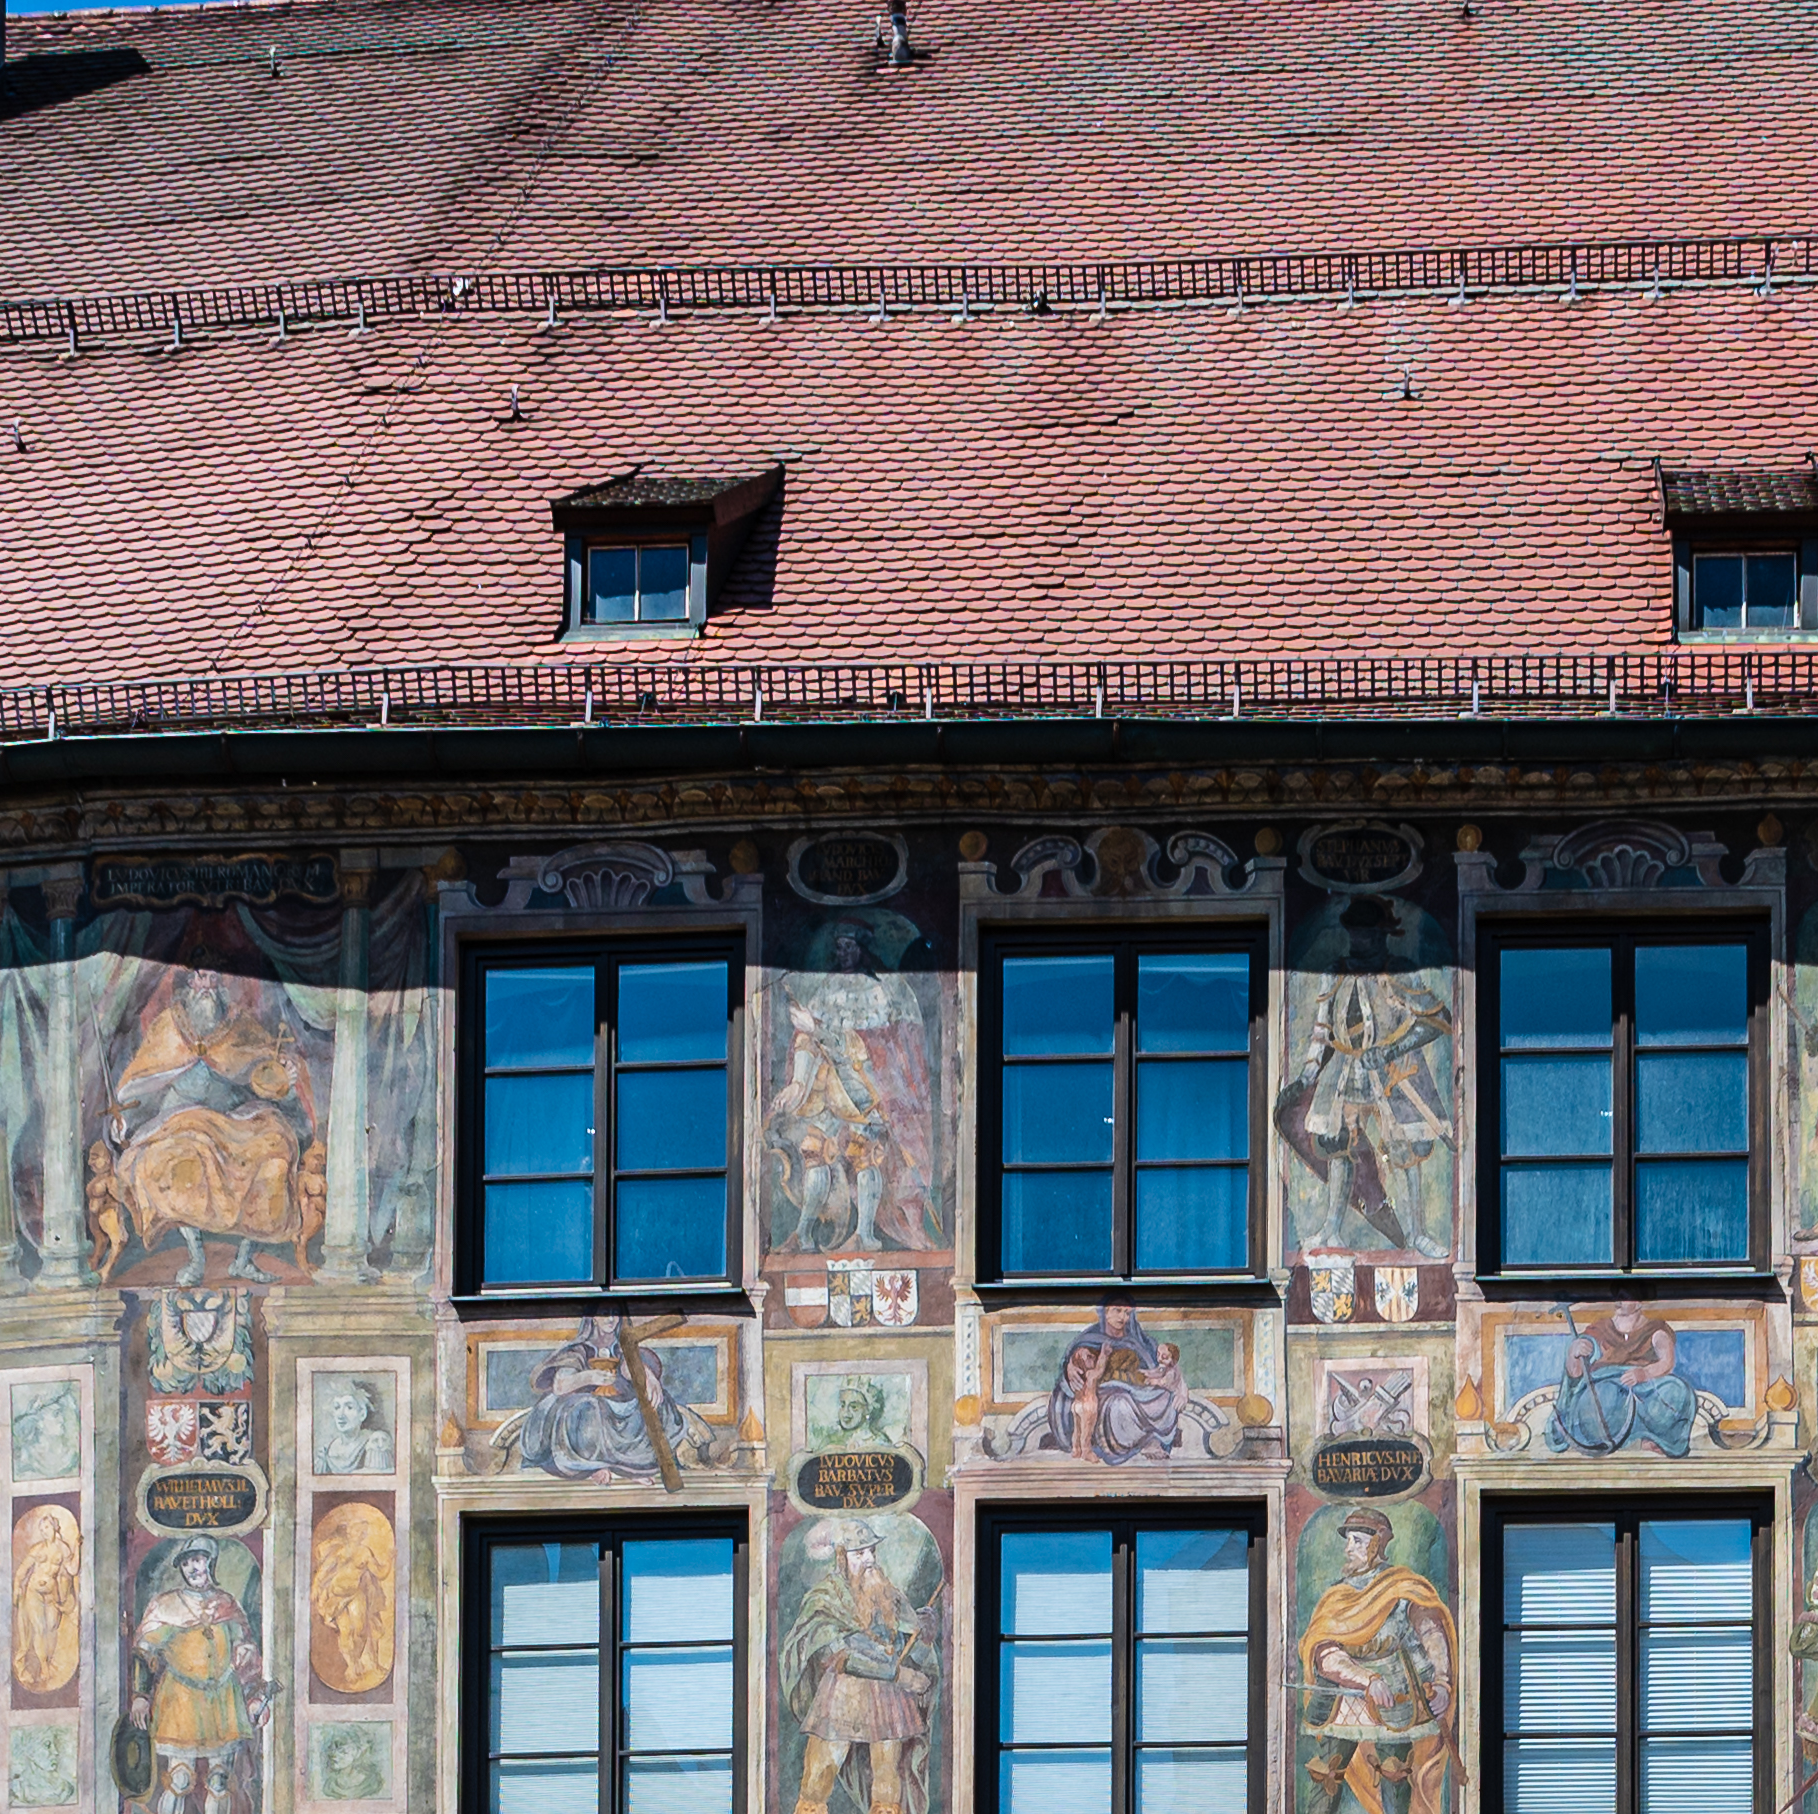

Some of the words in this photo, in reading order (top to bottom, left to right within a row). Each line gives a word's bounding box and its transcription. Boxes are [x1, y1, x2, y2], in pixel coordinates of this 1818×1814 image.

[819, 1454, 895, 1469] LVDOVICVS
[819, 1469, 894, 1483] BARBATVS
[1383, 1467, 1414, 1480] DVX
[848, 1482, 896, 1497] SVPER
[843, 1496, 876, 1510] DVX
[184, 1512, 220, 1526] DVX
